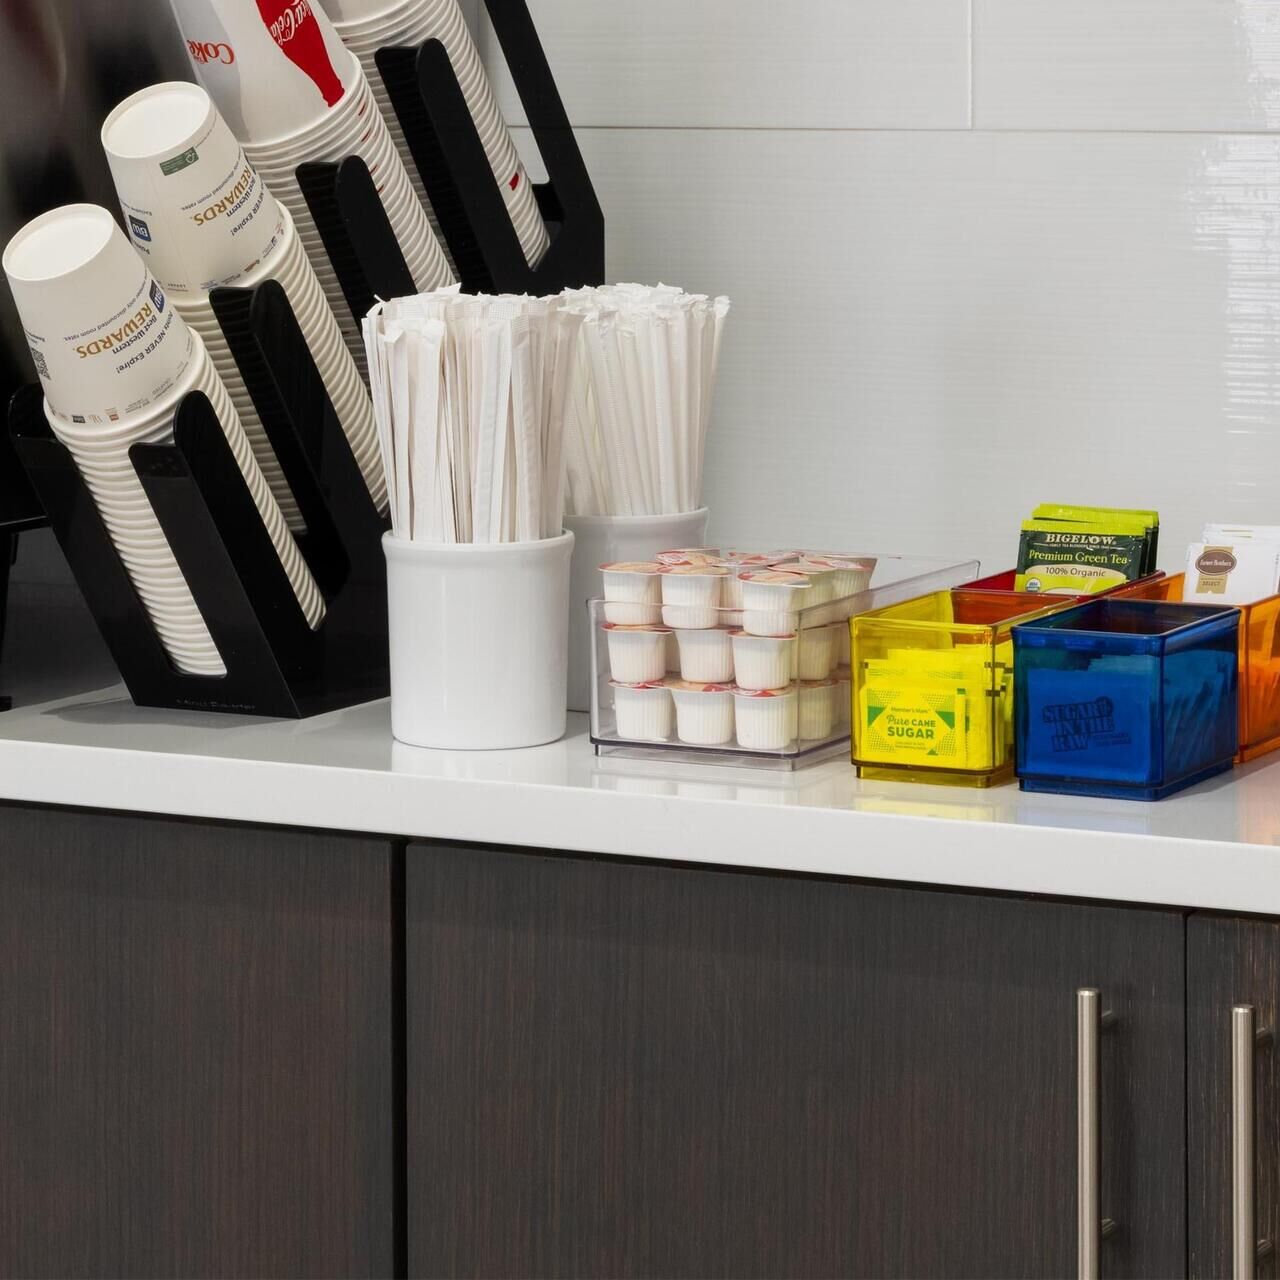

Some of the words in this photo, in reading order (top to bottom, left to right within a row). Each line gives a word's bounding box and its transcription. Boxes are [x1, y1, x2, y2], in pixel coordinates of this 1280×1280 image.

[186, 40, 234, 64] Coke
[193, 165, 252, 226] REWARDS
[230, 212, 253, 236] Expire!
[76, 303, 152, 359] REWARDS
[112, 330, 145, 354] Western
[145, 330, 167, 355] NEVER
[116, 352, 145, 374] Expire!
[1046, 534, 1115, 545] BIGELOW
[1029, 550, 1073, 562] Premium
[1075, 552, 1108, 564] Green
[1110, 554, 1128, 564] Tea
[1046, 567, 1068, 576] 100%
[1071, 568, 1106, 578] Organic
[887, 714, 910, 726] Pure
[912, 719, 936, 728] CANE
[888, 727, 934, 740] SUGAR
